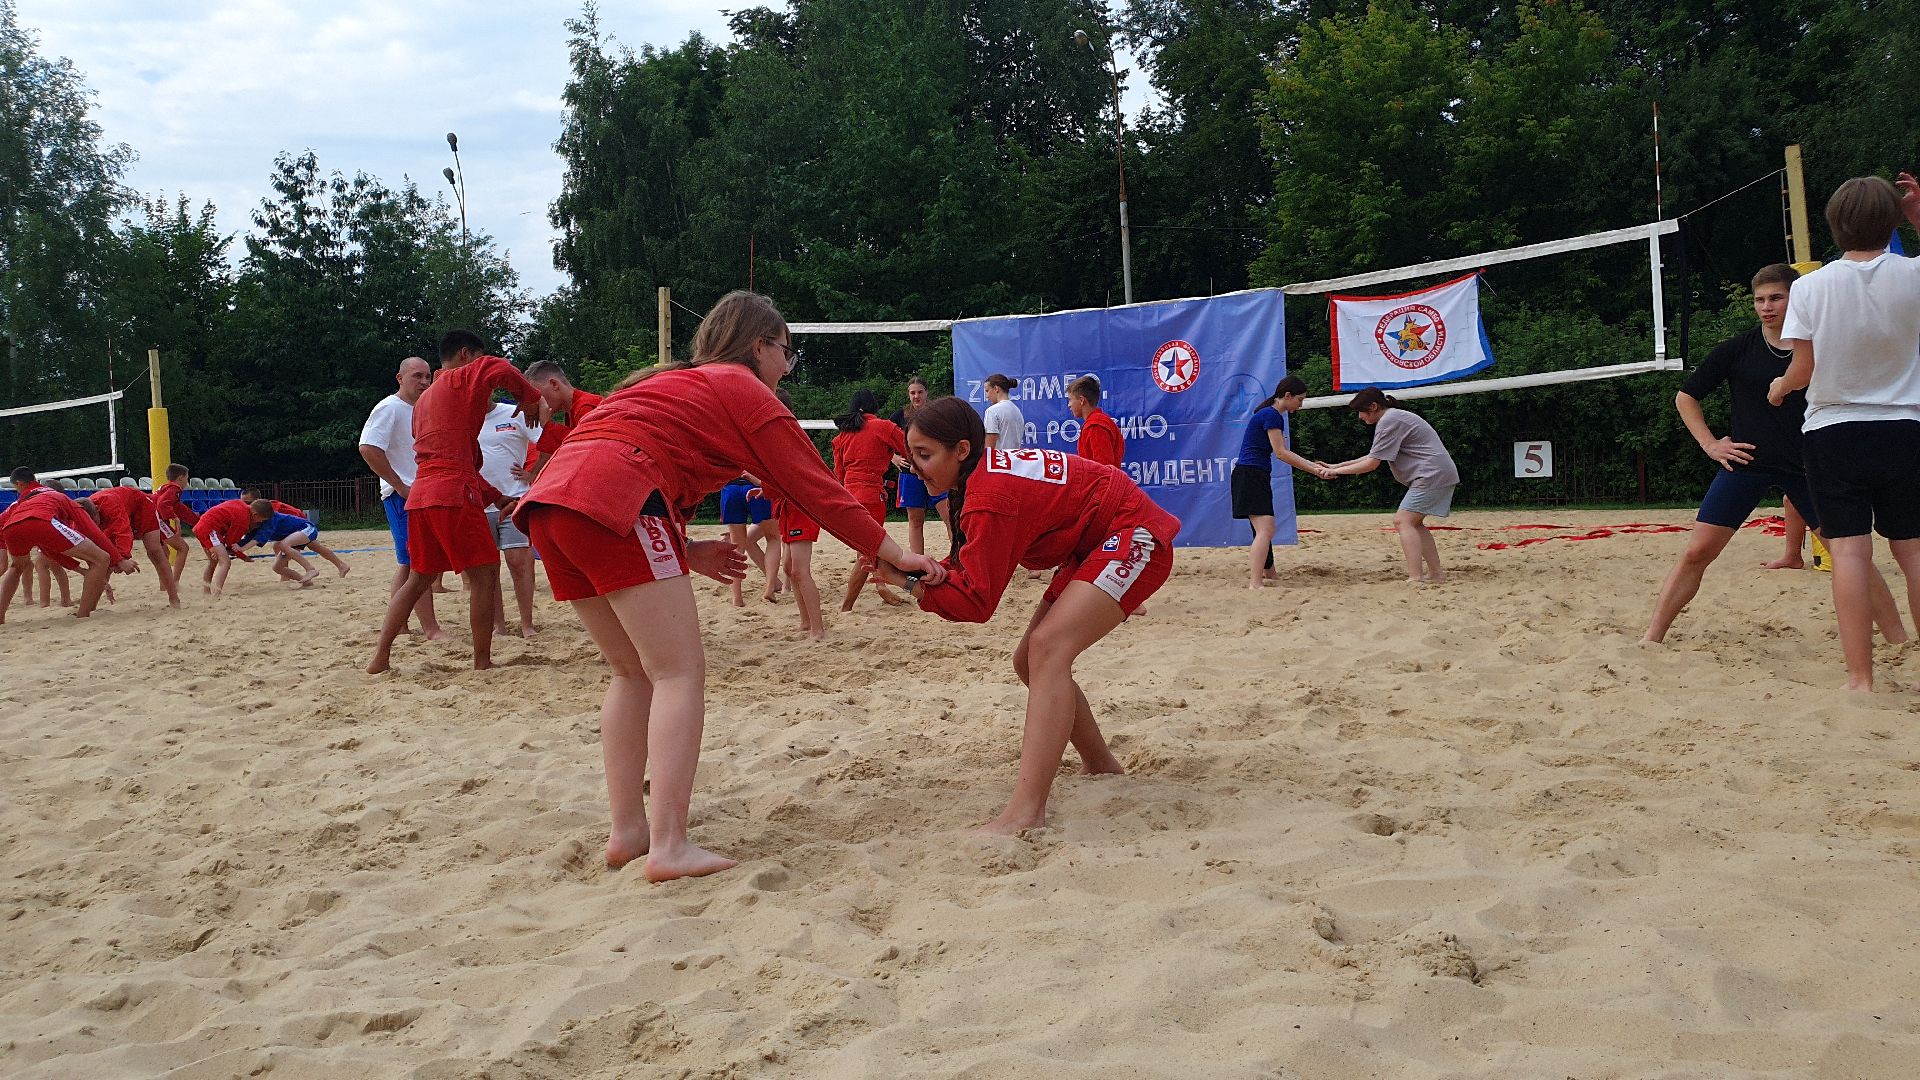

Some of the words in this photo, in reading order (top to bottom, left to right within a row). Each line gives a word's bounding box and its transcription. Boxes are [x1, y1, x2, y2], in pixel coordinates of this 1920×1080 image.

[1377, 305, 1415, 334] ФЕДЕРАЦИЯ
[1417, 305, 1440, 323] САМБО
[1379, 343, 1425, 368] МОСКОВСКОЙ
[1424, 330, 1445, 363] ОБЛАСТИ
[1159, 380, 1192, 391] САМБО
[1046, 414, 1176, 444] РОИЮ.
[1524, 444, 1544, 474] 5
